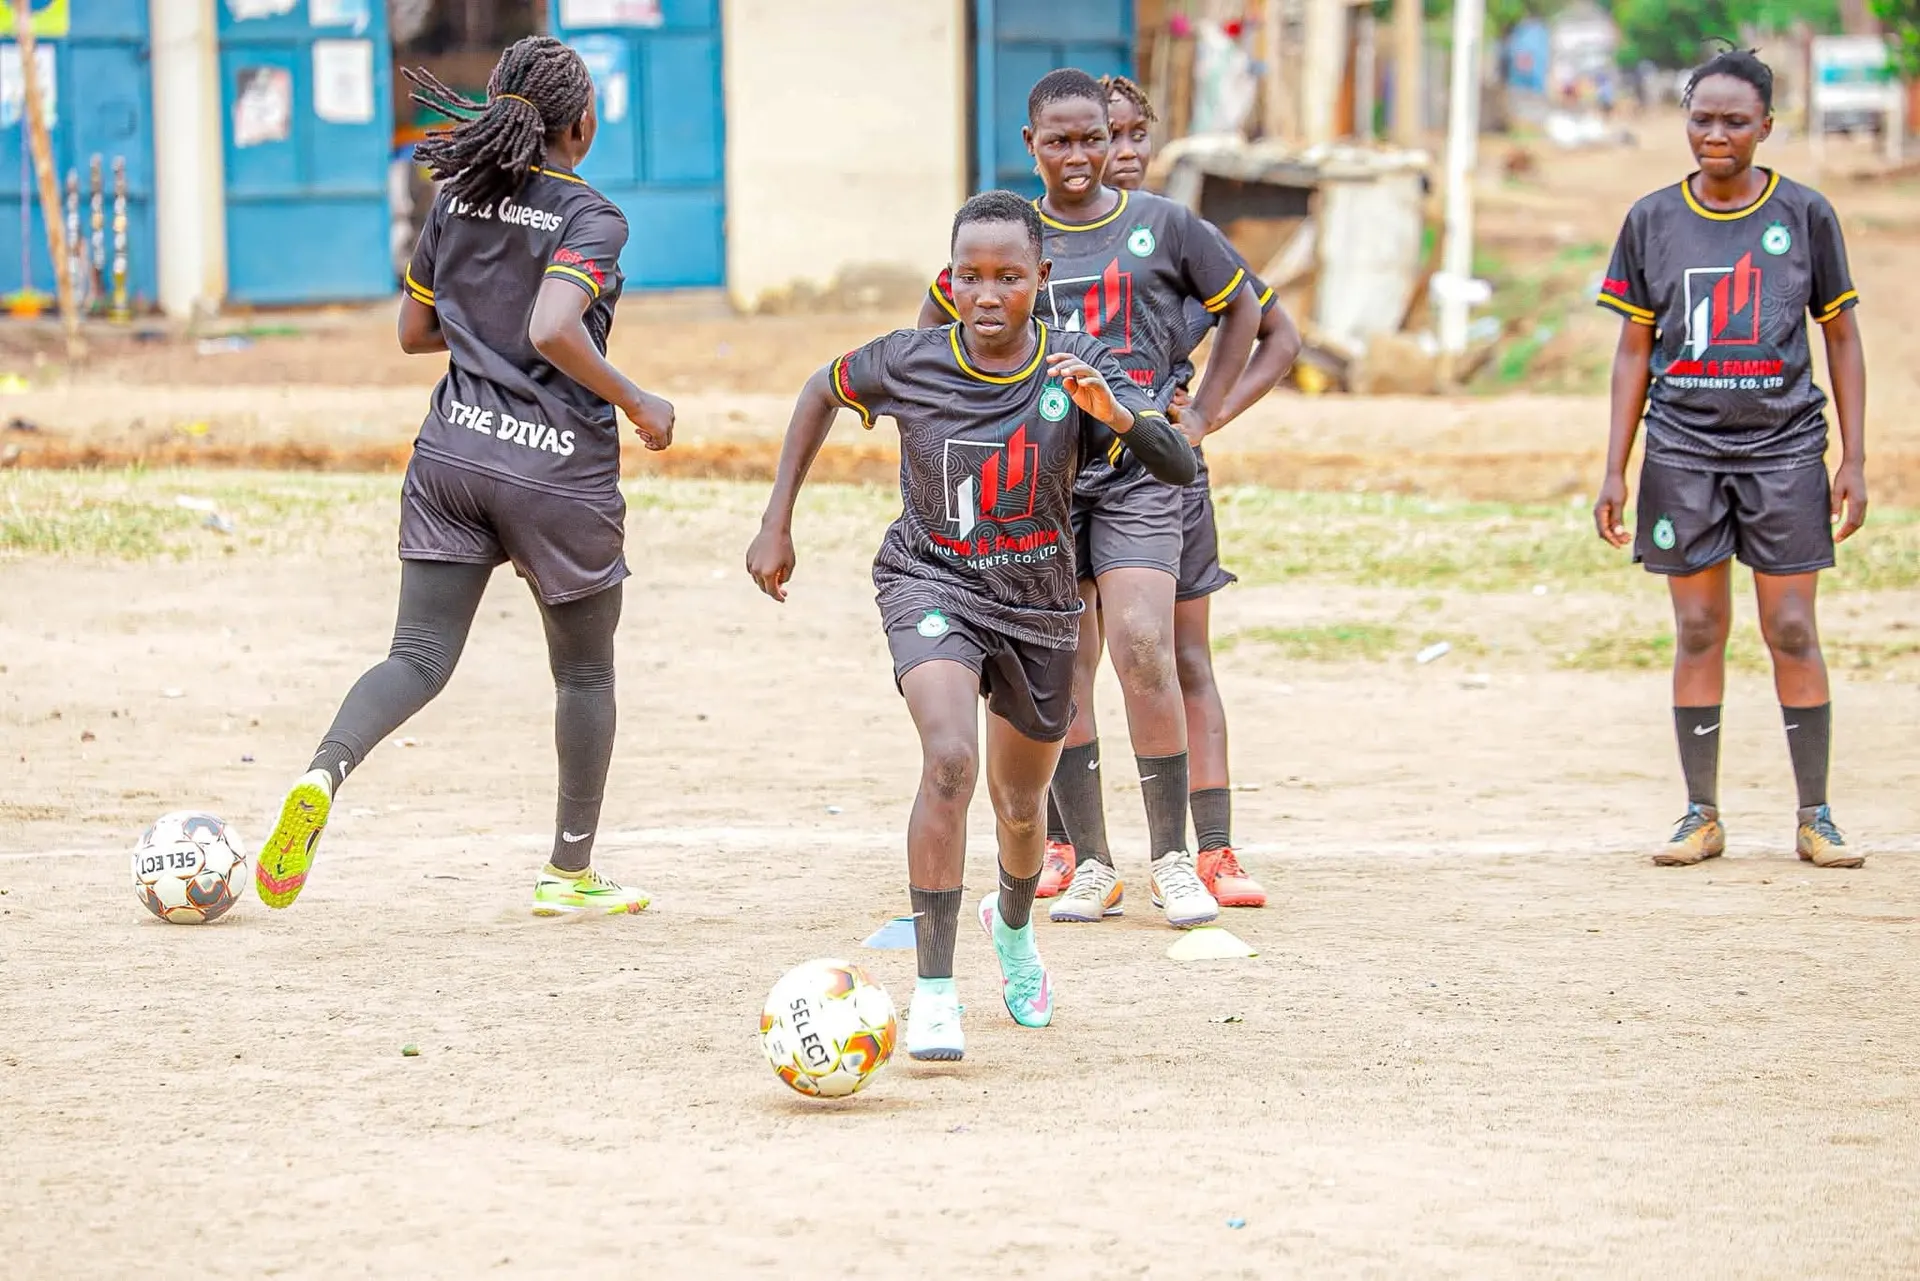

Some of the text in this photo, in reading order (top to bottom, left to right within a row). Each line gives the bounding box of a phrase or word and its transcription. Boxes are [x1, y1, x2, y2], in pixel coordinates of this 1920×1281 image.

[499, 196, 562, 231] Queens
[1722, 360, 1784, 376] FAMILY
[1664, 377, 1784, 389] INVESTMENTS CO. LTD
[448, 400, 575, 456] THE DIVAS
[995, 530, 1060, 552] FAMILY
[1015, 553, 1036, 564] CO.
[1039, 545, 1058, 561] LTD
[141, 852, 196, 875] SELECT
[790, 998, 830, 1067] SELECT
